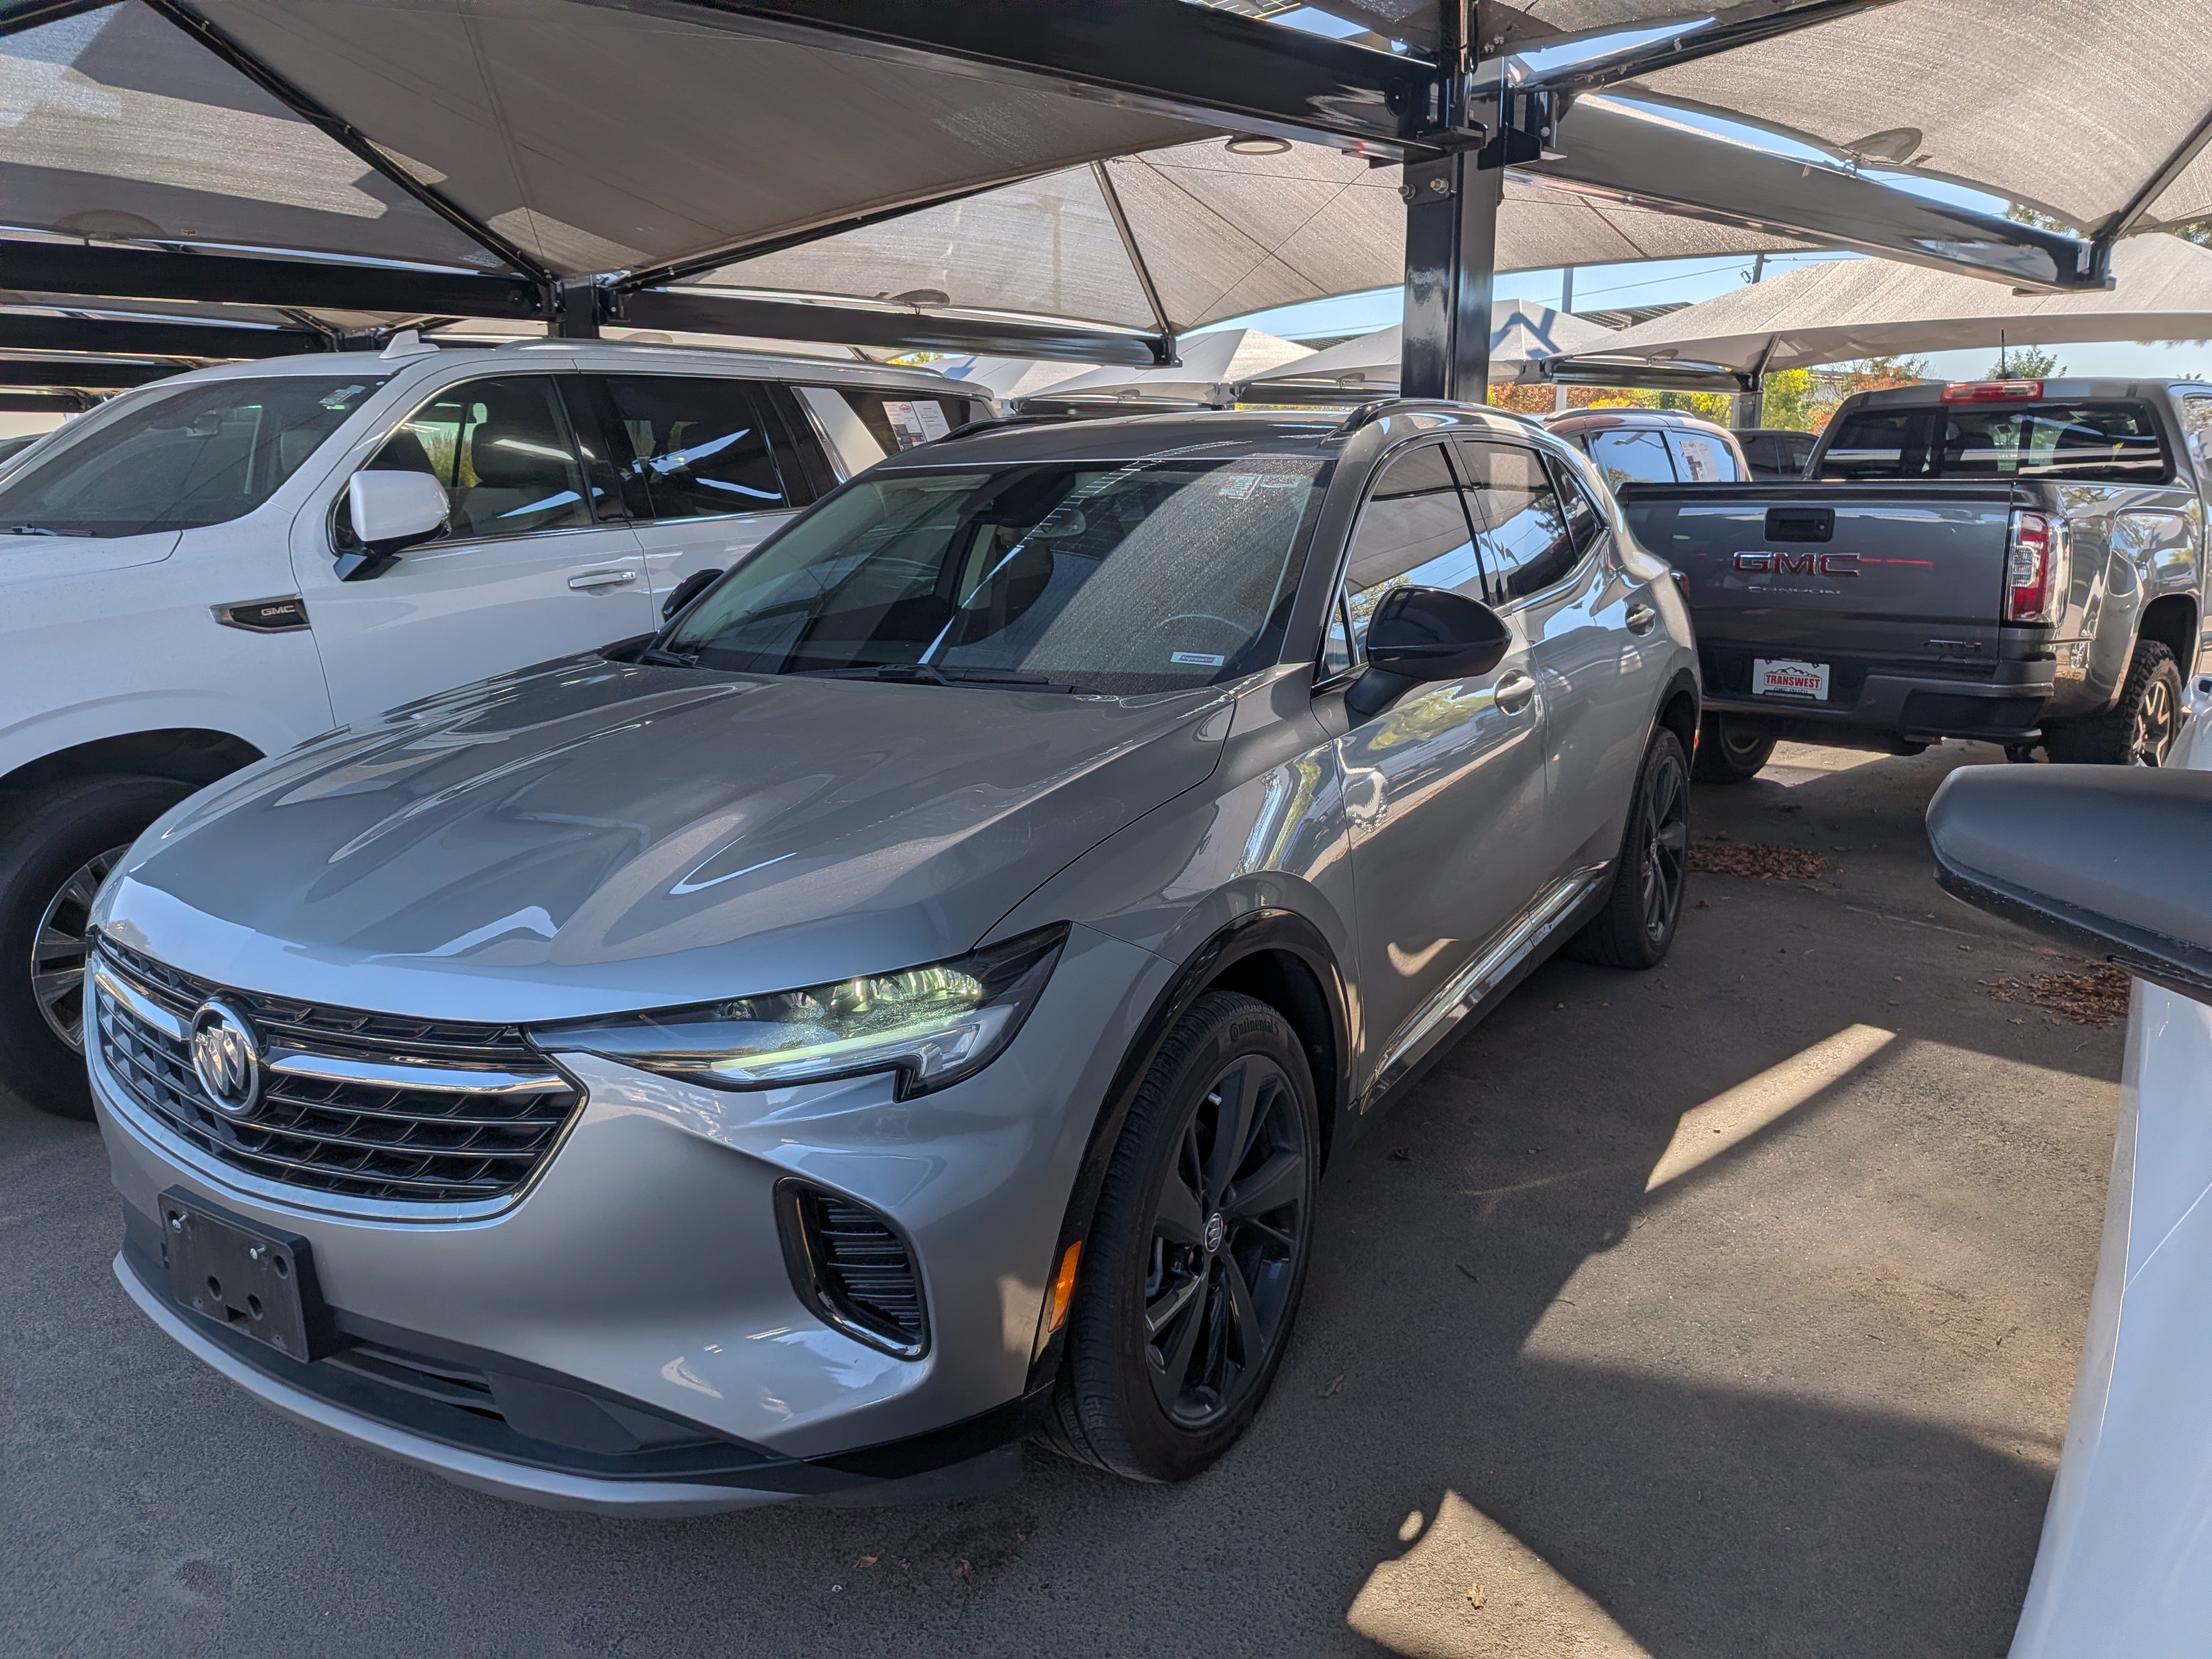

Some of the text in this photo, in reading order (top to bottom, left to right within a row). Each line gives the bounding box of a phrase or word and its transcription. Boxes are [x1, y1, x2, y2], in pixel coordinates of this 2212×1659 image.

[1733, 551, 1860, 576] GMC
[260, 605, 296, 616] GMC
[1766, 675, 1820, 688] TRANSWEST
[1229, 1017, 1274, 1042] Continental
